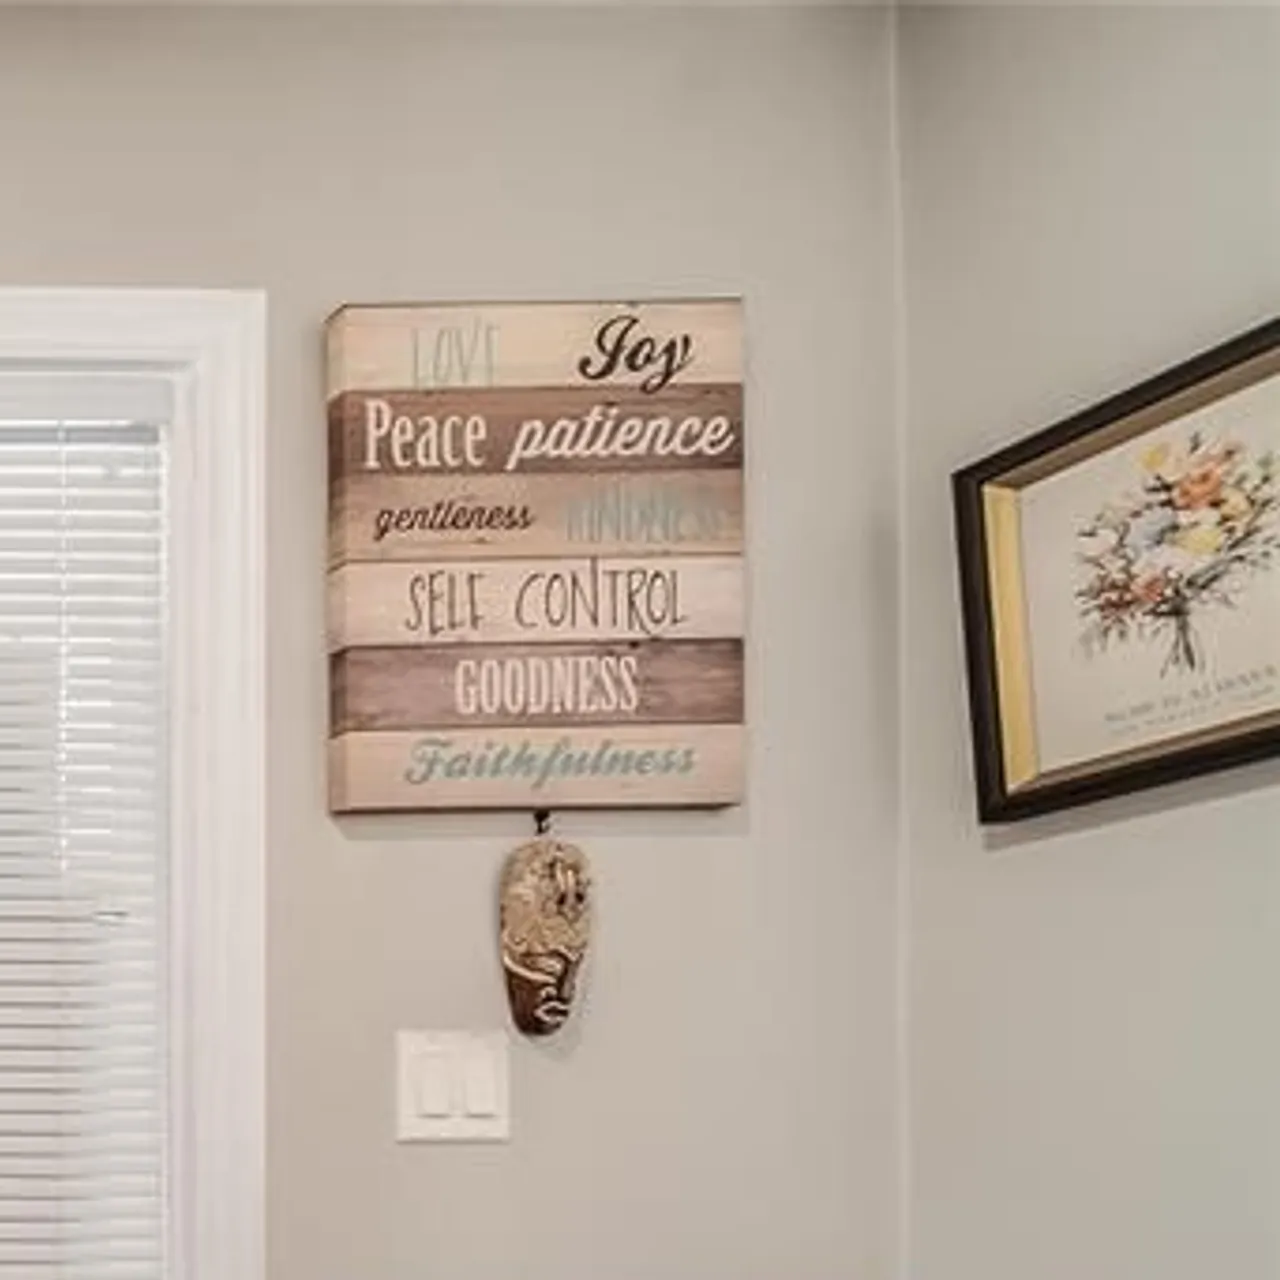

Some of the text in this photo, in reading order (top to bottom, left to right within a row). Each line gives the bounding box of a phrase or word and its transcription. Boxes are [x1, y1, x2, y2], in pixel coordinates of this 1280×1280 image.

[578, 314, 694, 394] Joy
[365, 399, 735, 472] Peace patience
[373, 500, 537, 543] gentleness
[405, 557, 689, 636] SELF CONTROL
[454, 655, 641, 715] GOODNESS
[402, 736, 698, 789] Faithfulness
